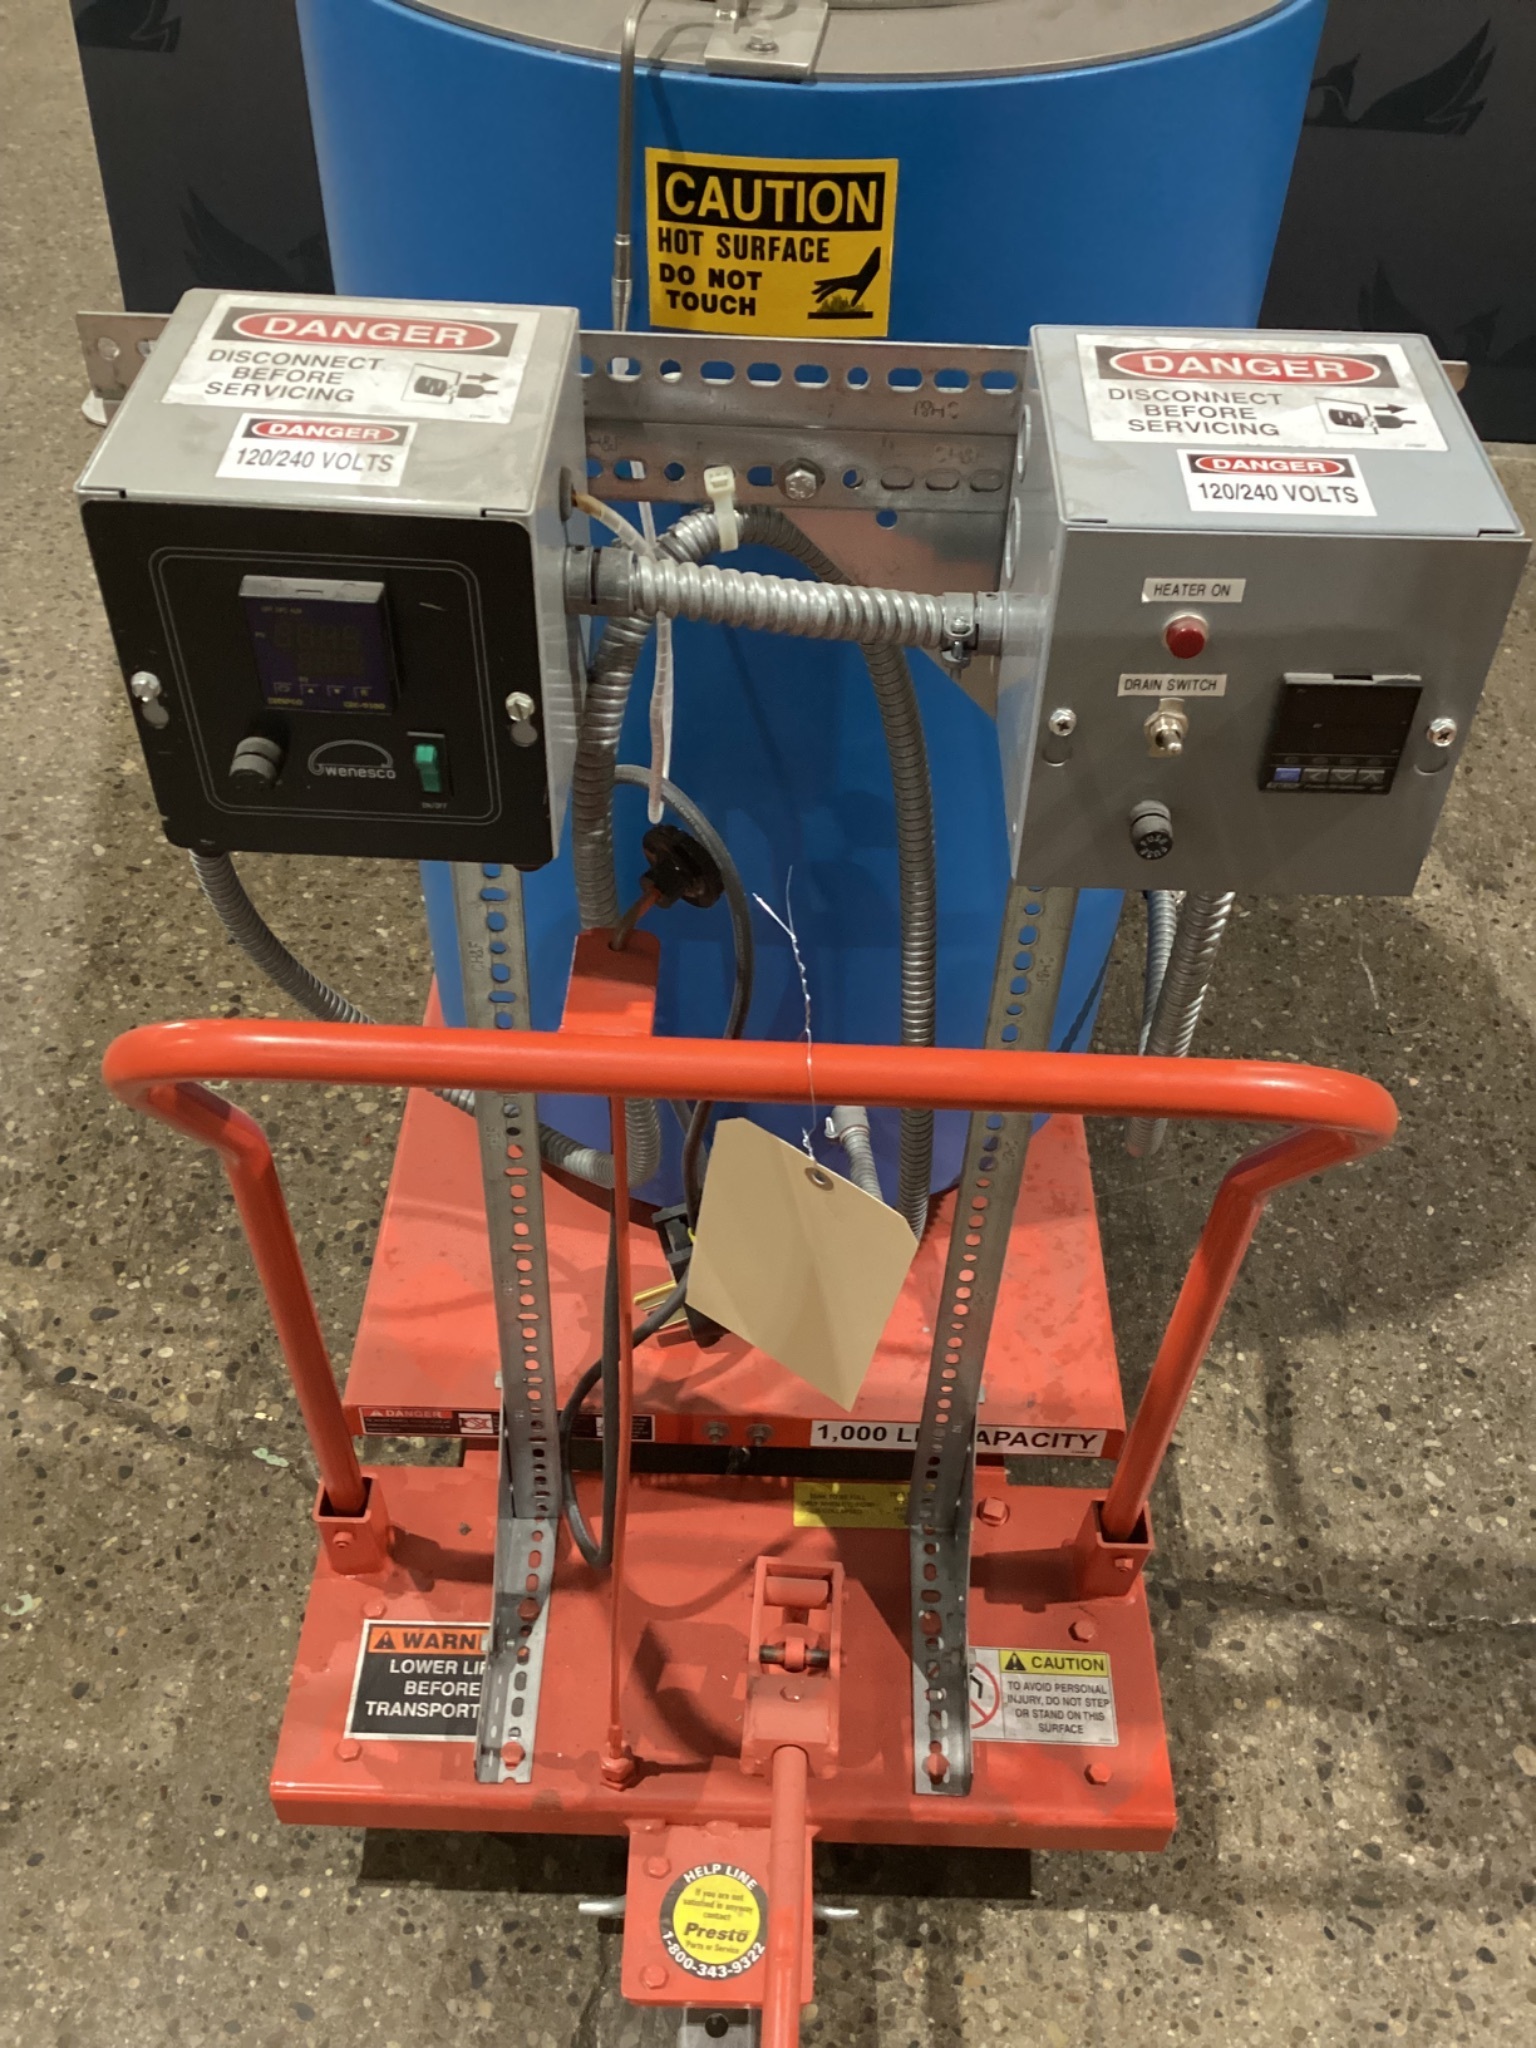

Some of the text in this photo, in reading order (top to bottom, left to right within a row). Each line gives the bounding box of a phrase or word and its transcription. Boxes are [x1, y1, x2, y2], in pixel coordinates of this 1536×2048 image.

[665, 171, 877, 225] CAUTION
[658, 226, 830, 263] HOT SURFACE
[659, 262, 762, 291] DO NOT
[665, 289, 756, 317] TOUCH
[262, 316, 469, 346] DANGER
[207, 349, 385, 371] DISCONNECT
[1141, 353, 1349, 380] DANGER
[231, 367, 344, 385] BEFORE
[203, 381, 355, 402] SERVICING
[1107, 387, 1283, 406] DISCONNECT
[1143, 403, 1257, 420] BEFORE
[267, 422, 382, 441] DANGER
[1128, 418, 1280, 437] SERVICING
[236, 447, 394, 473] 120/240 VOLTS
[1212, 457, 1327, 474] DANGER
[1197, 482, 1359, 504] 120/240 VOLTS
[1153, 583, 1231, 597] HEATER ON
[1124, 678, 1217, 691] DRAIN SWITCH
[325, 766, 396, 779] wenesco
[385, 1409, 441, 1418] DANGER
[817, 1424, 920, 1443] 1,000 L
[977, 1429, 1098, 1450] APACITY
[389, 1659, 457, 1675] LOWER
[1031, 1656, 1105, 1672] CAUTION
[404, 1681, 481, 1697] BEFORE
[1008, 1680, 1107, 1695] TO AVOID PERSONAL
[1008, 1695, 1110, 1708] INJURY, DO NOT STEP
[1015, 1709, 1105, 1722] OR STAND ON THIS
[1038, 1723, 1084, 1734] SURFACE
[683, 1863, 758, 1890] HELP LINE
[703, 1912, 731, 1921] contact
[684, 1922, 750, 1943] Presto
[662, 1930, 766, 1978] 1-800-343-9322
